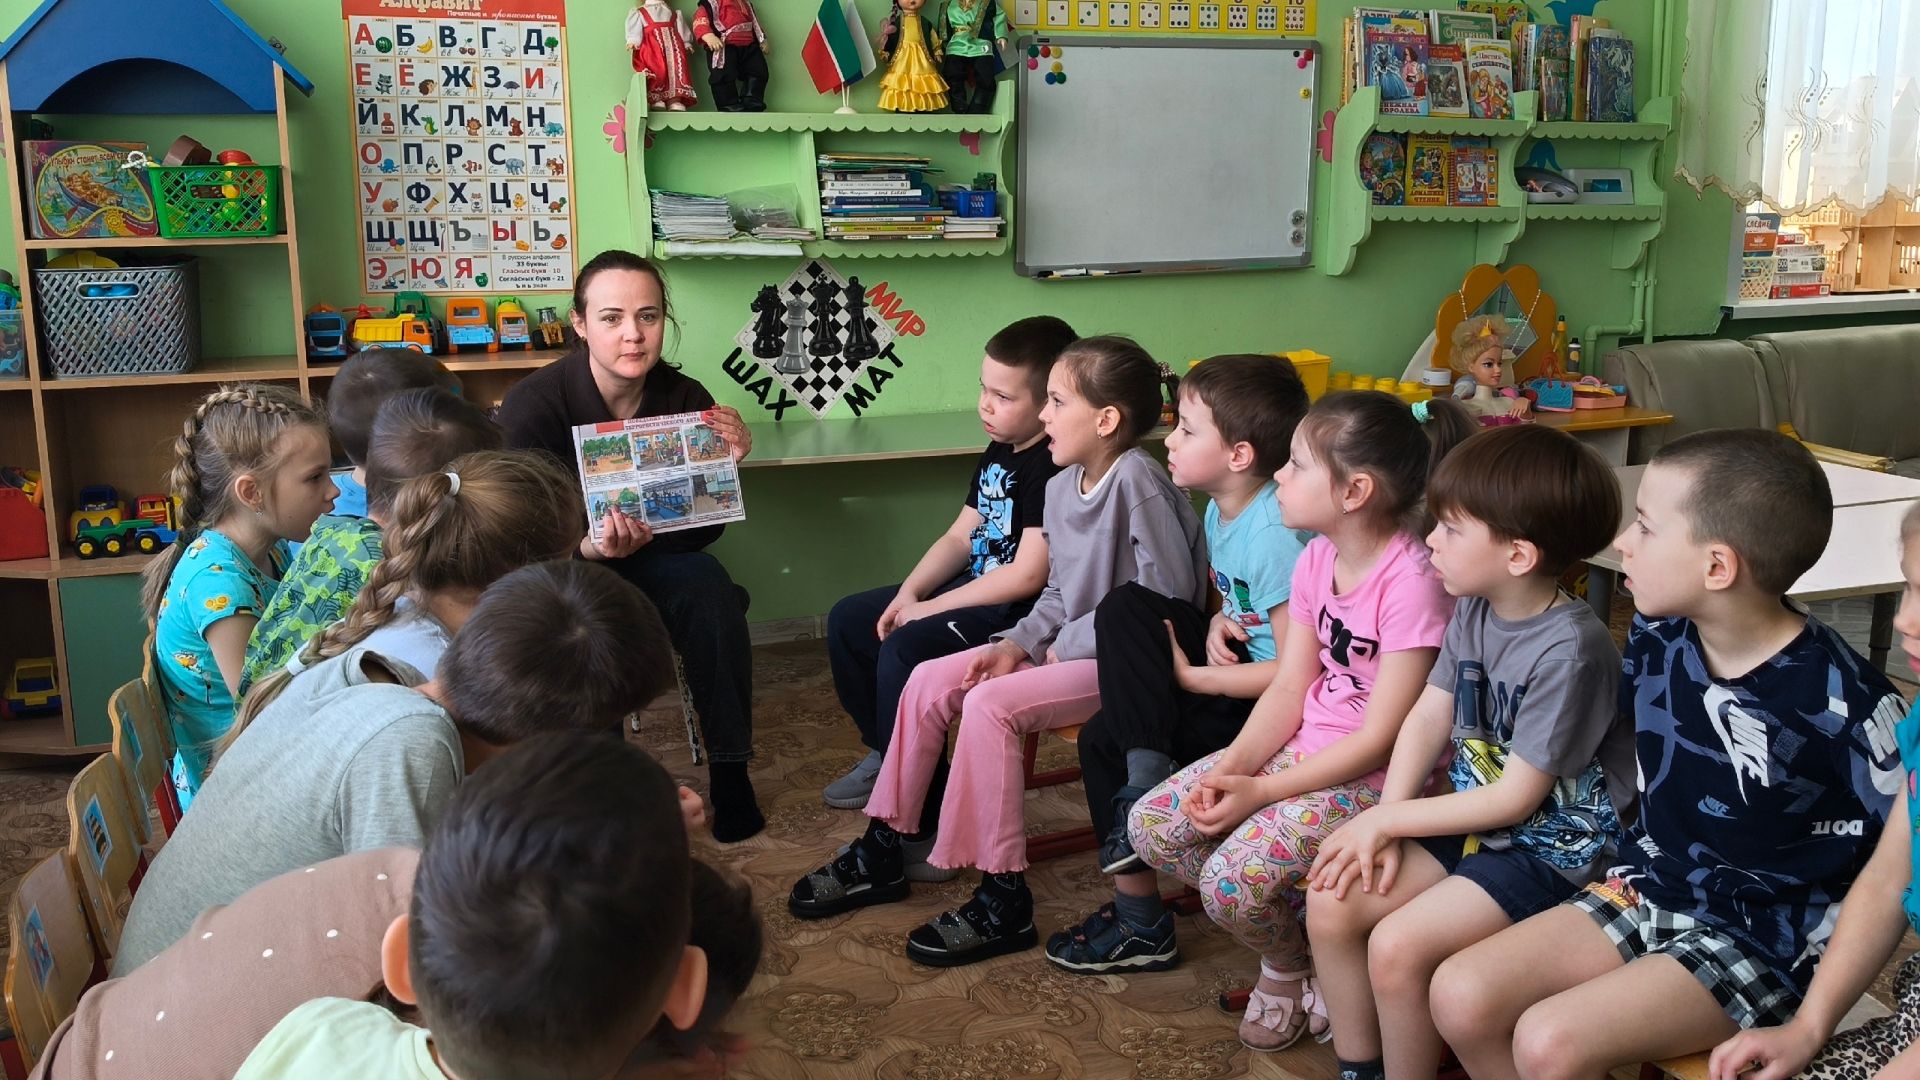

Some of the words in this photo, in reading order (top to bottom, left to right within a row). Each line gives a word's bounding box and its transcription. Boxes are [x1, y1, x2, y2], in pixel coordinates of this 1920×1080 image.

[355, 23, 374, 45] А
[396, 25, 415, 46] Б
[439, 26, 457, 47] В
[482, 27, 496, 48] Г
[523, 29, 545, 55] Д
[356, 63, 372, 85] Е
[399, 58, 415, 86] Ё
[442, 66, 473, 88] Ж
[484, 66, 501, 88] З
[525, 68, 544, 89] И
[358, 98, 378, 125] Й
[401, 104, 421, 125] К
[444, 105, 465, 126] Л
[486, 106, 509, 126] М
[527, 106, 545, 127] Н
[361, 143, 382, 164] О
[404, 143, 423, 164] П
[446, 144, 463, 164] Р
[488, 144, 506, 165] С
[528, 145, 545, 165] Т
[363, 182, 383, 203] У
[406, 182, 430, 203] Ф
[448, 183, 468, 203] Х
[490, 183, 511, 208] Ц
[531, 183, 548, 203] Ч
[366, 221, 395, 242] Ш
[408, 221, 440, 246] Щ
[449, 221, 471, 241] Ъ
[493, 221, 516, 241] Ы
[534, 221, 550, 241] Ь
[368, 258, 387, 280] Э
[411, 258, 442, 279] Ю
[454, 258, 472, 278] Я
[864, 281, 926, 337] МИР
[722, 346, 798, 422] ШАХ
[843, 342, 903, 417] МАТ
[1832, 820, 1864, 836] DO
